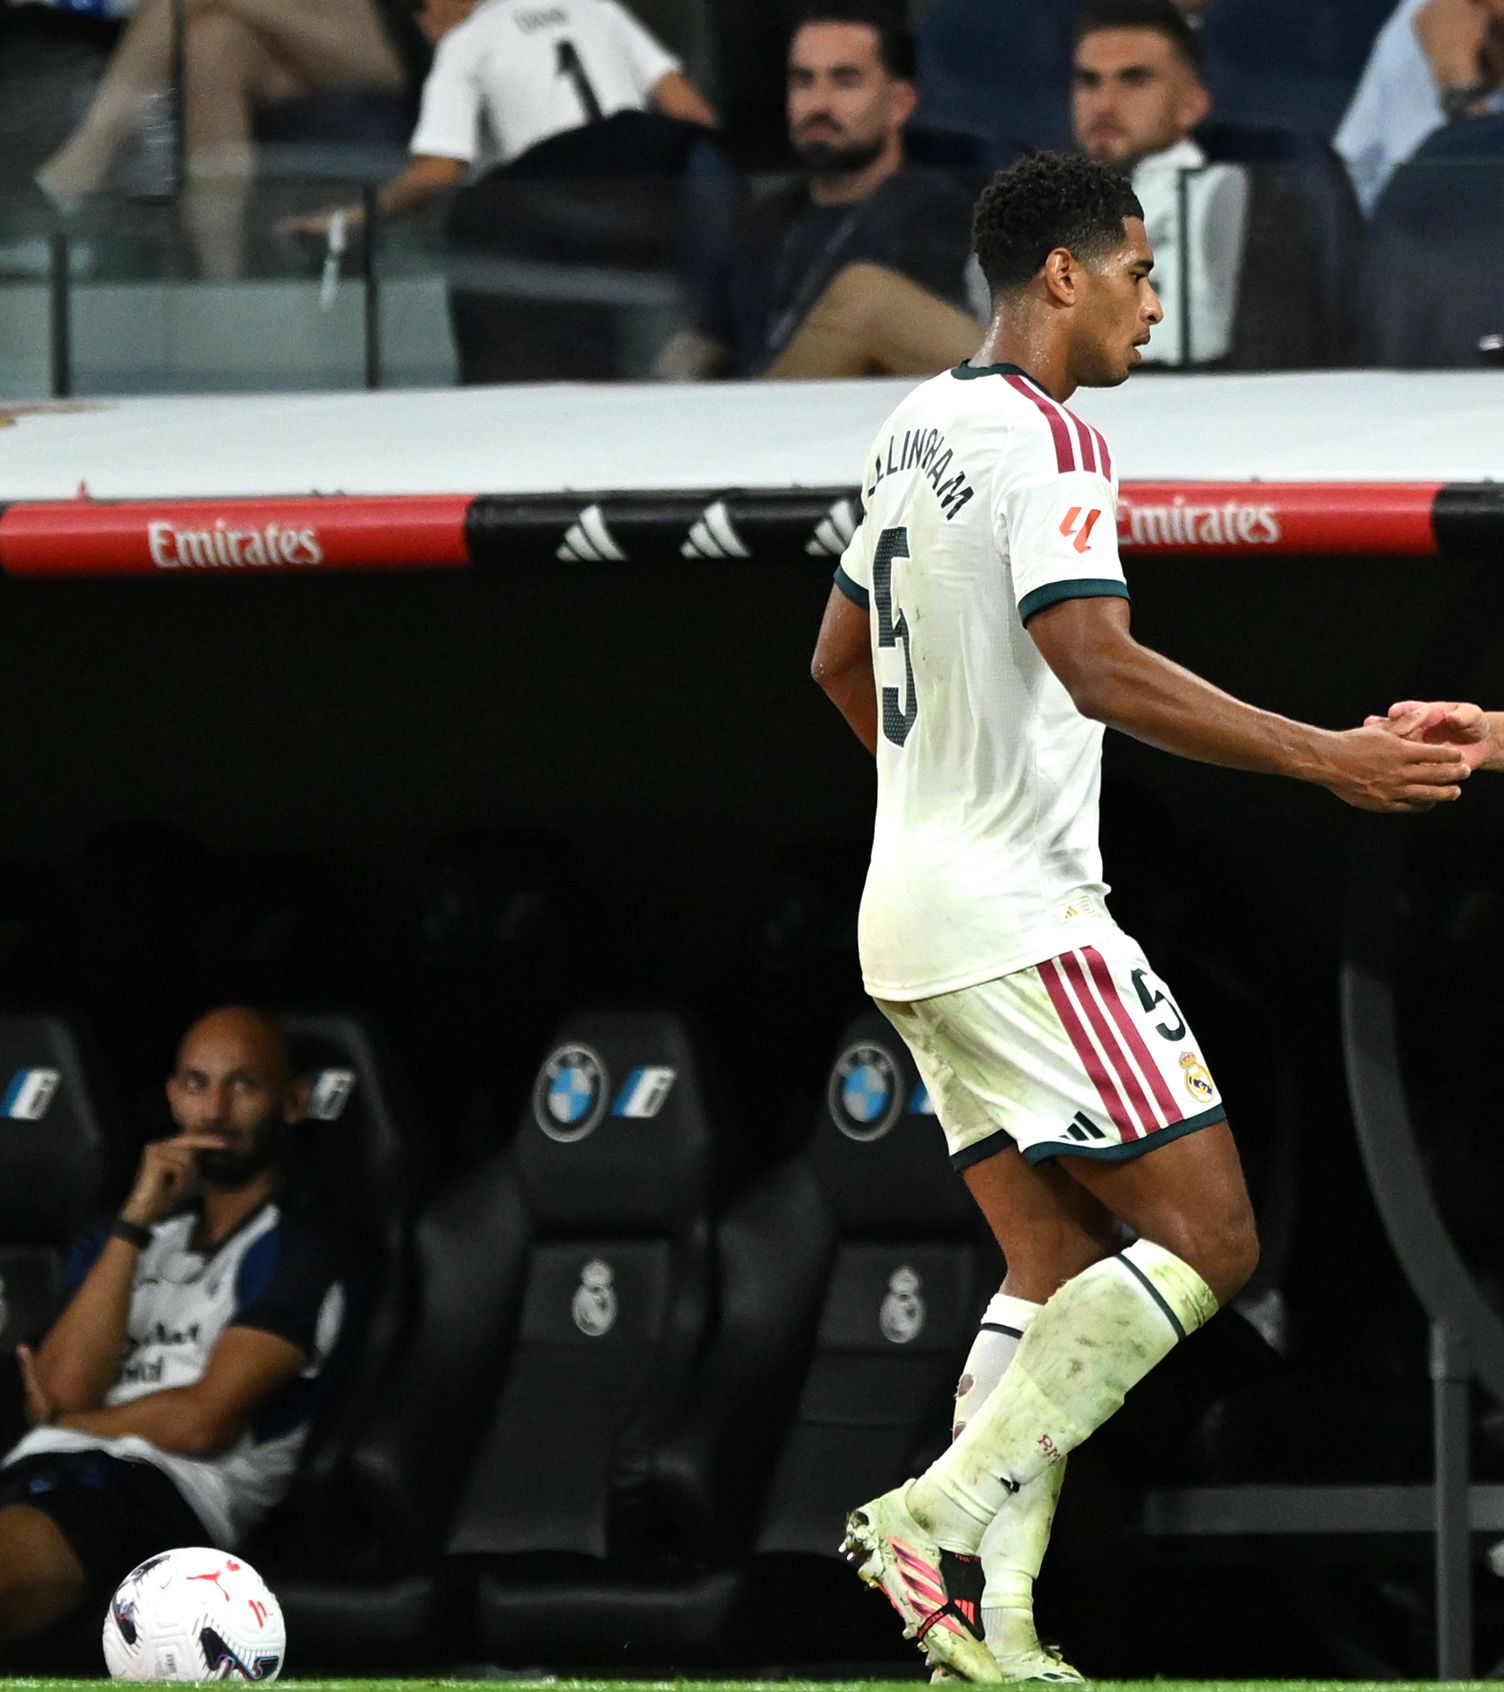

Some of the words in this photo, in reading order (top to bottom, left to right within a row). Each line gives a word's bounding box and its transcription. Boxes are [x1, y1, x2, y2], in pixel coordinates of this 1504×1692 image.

[148, 518, 322, 568] Emirates
[872, 526, 918, 748] 5
[1130, 968, 1186, 1042] 5
